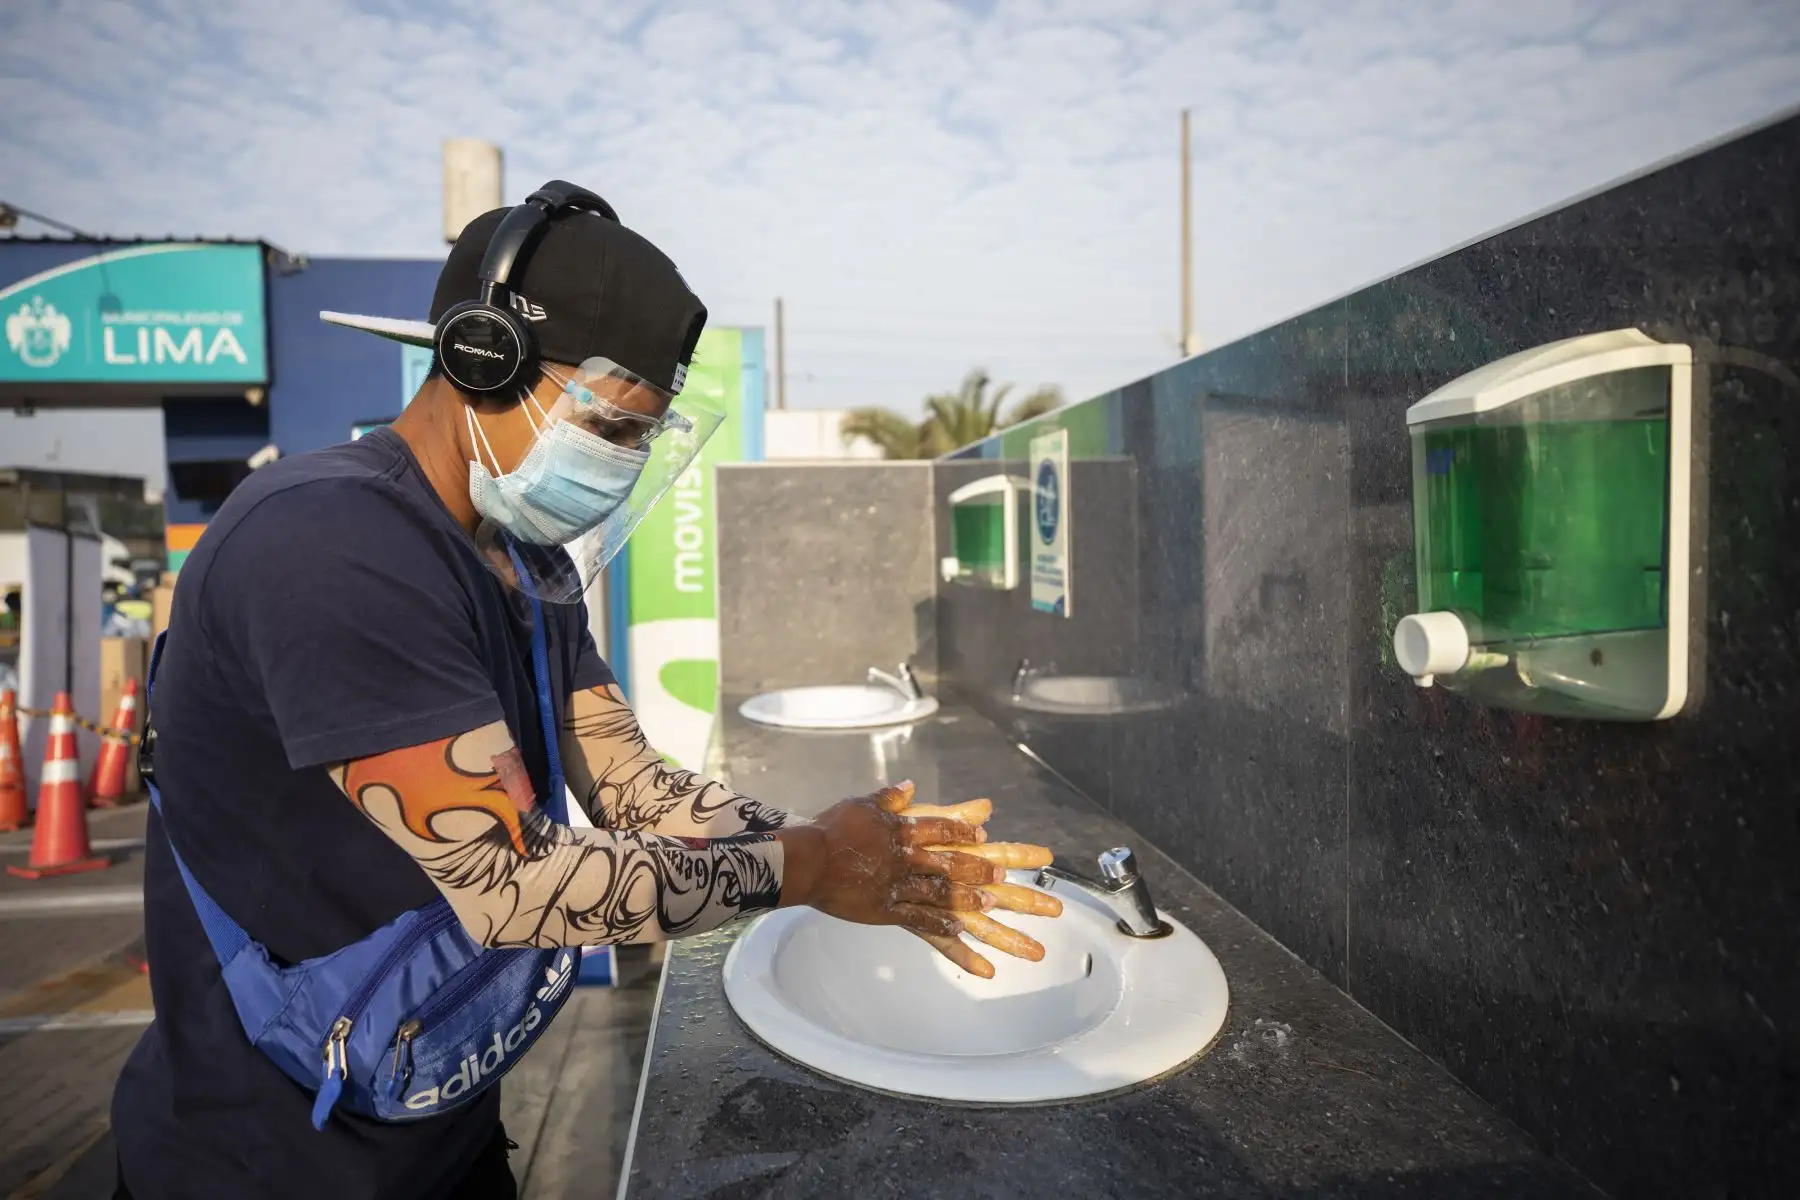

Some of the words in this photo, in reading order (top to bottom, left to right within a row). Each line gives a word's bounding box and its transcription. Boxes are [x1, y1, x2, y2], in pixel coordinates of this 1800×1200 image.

[104, 326, 248, 364] LIMA
[454, 343, 504, 360] ROMAX
[404, 1002, 541, 1109] adidas
